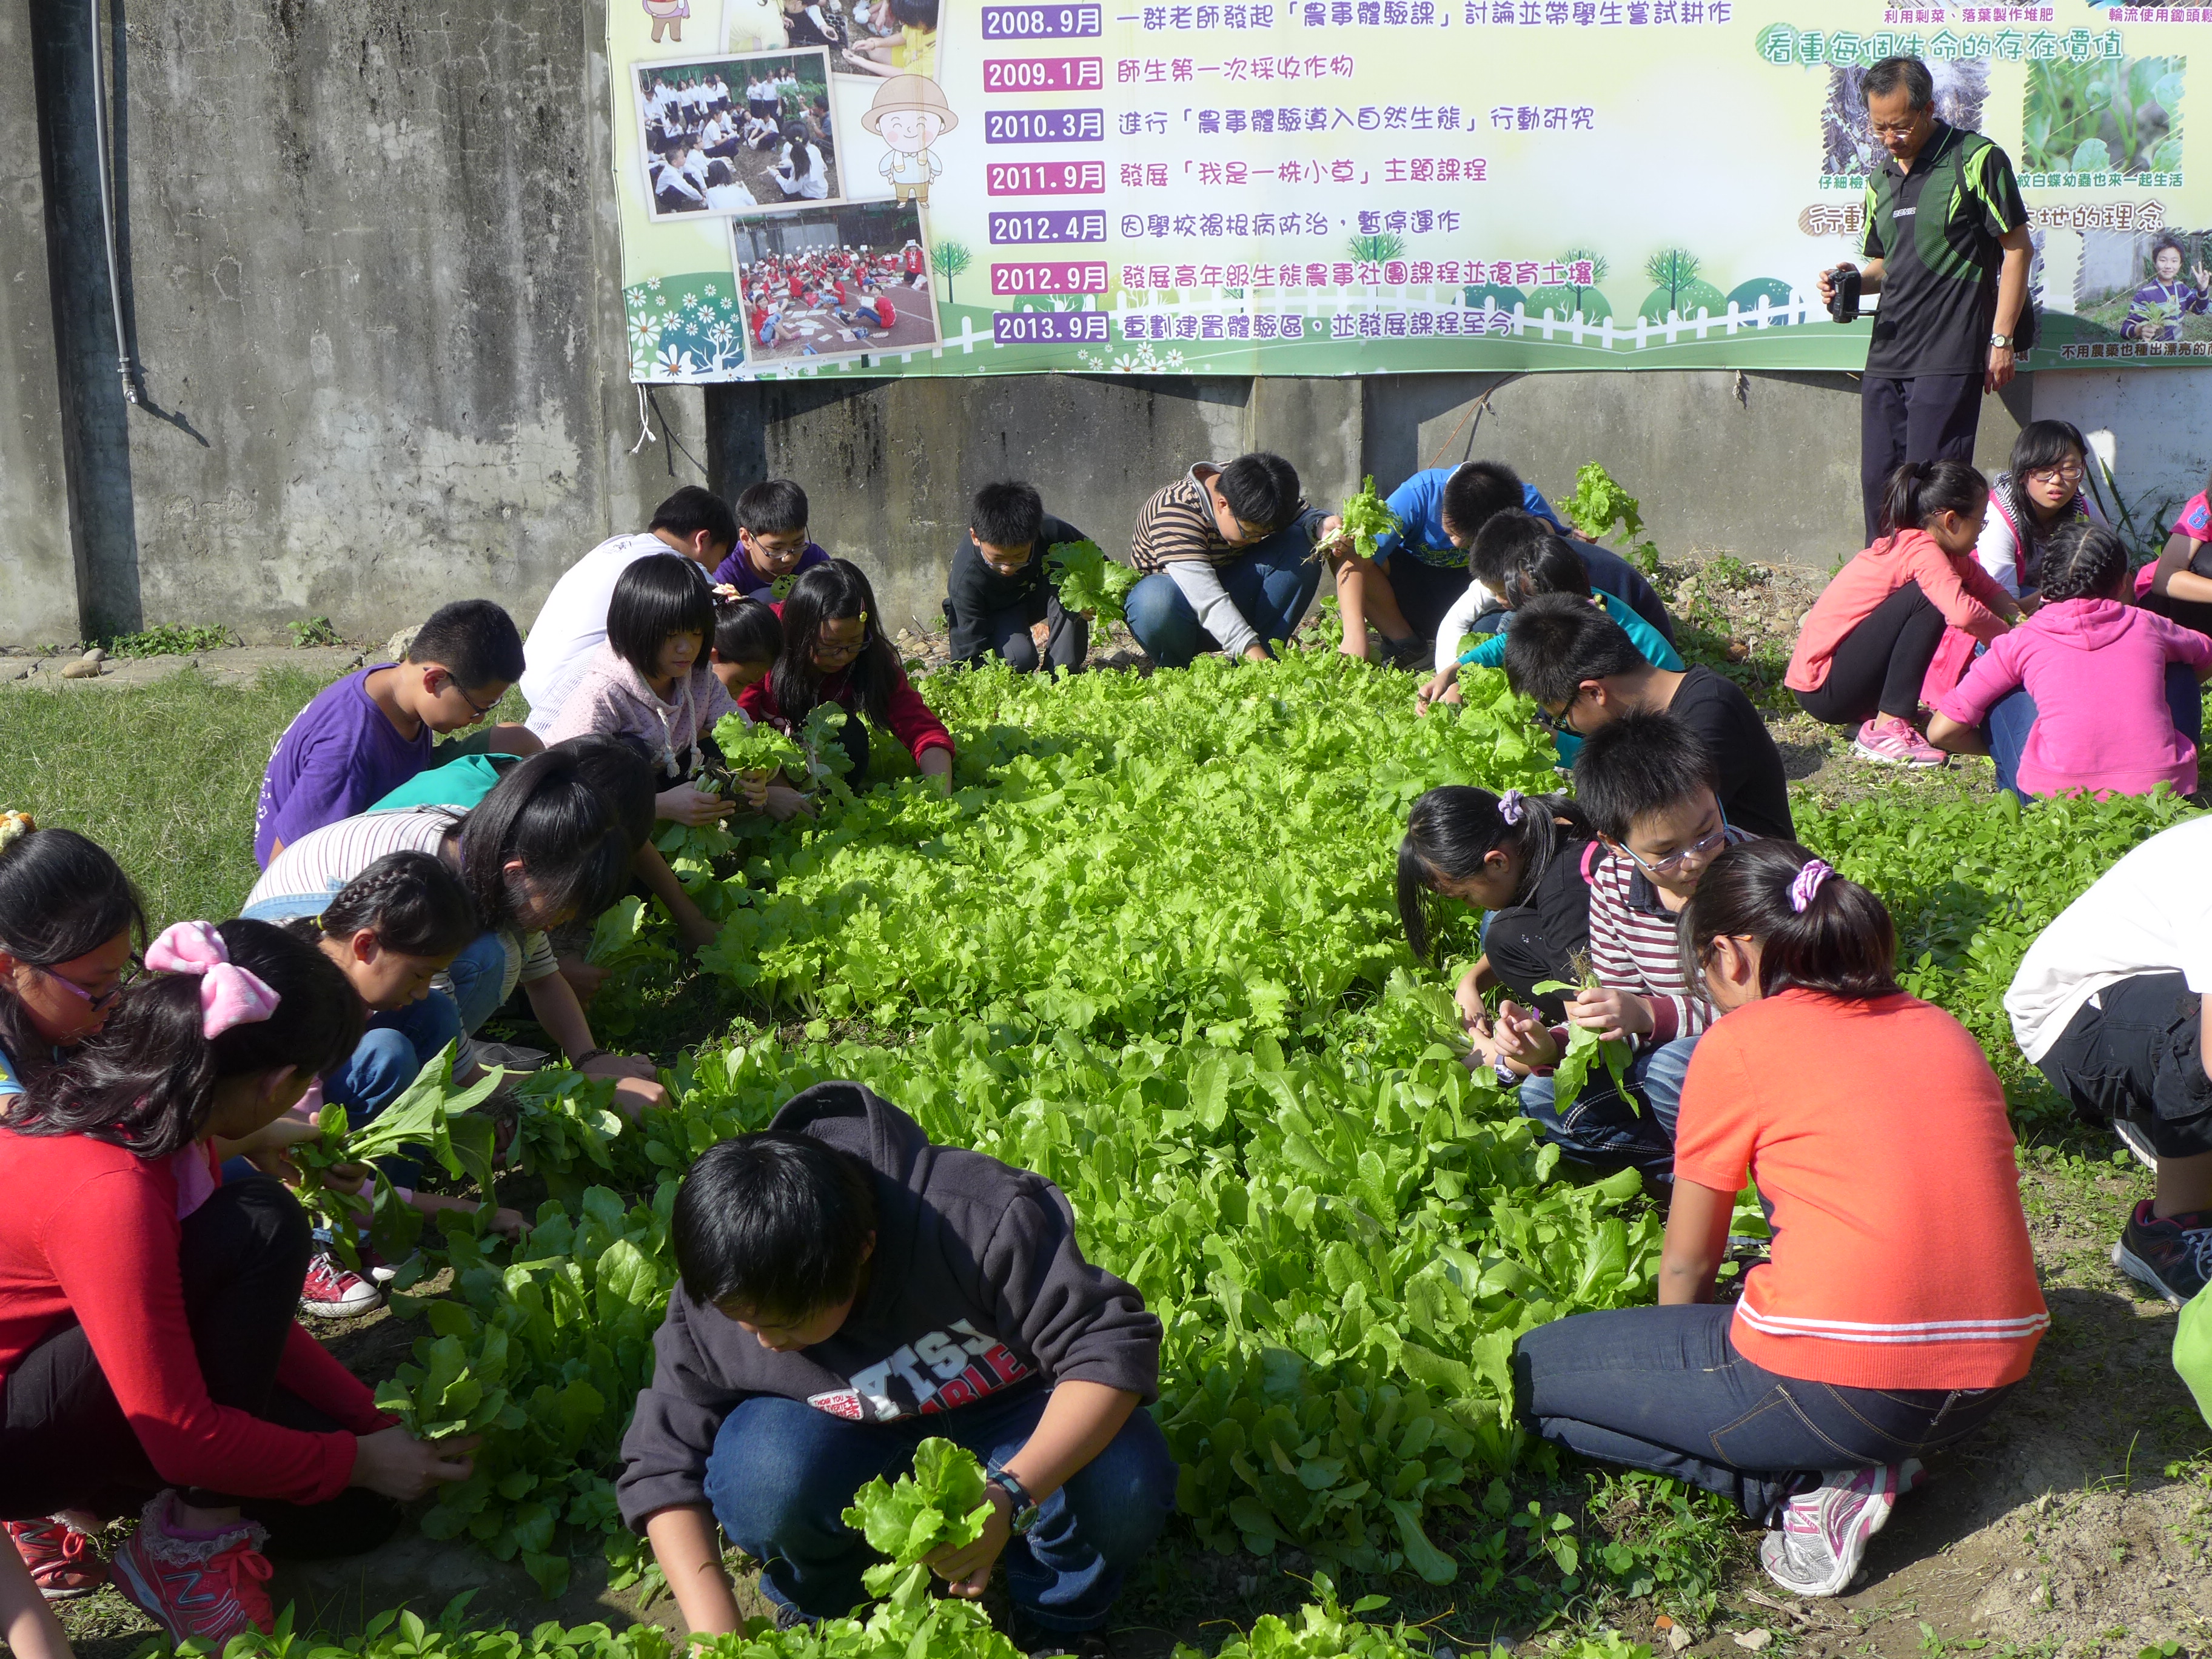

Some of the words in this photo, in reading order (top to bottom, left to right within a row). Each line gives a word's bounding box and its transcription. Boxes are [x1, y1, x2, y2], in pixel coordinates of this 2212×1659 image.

[987, 8, 1099, 35] 2008.9月
[1884, 8, 2054, 24] 利用剩菜、落葉製作堆肥
[1766, 28, 2122, 62] 看重每個生命的存在價值
[988, 59, 1101, 88] 2009.1月
[1117, 55, 1353, 82] 師生第一次採收作物
[991, 111, 1102, 139] 2010.3月
[1119, 106, 1594, 135] 進行「農事體驗導入自然生態」行動研究
[991, 164, 1103, 191] 2011.9月
[1120, 158, 1487, 187] 發展「我是一株小草」主題課程
[1818, 175, 1869, 190] 仔細檢
[994, 212, 1105, 241] 2012.4月
[1121, 210, 1460, 238] 因學校褐根病防治，暫停運作
[996, 265, 1106, 293] 2012.9月
[1122, 261, 1594, 289] 發展高年級生態農事社團課程並復育土壤
[999, 314, 1108, 342] 2013.9月
[1124, 311, 1512, 339] 重劃建置體驗區，並發展課程至今
